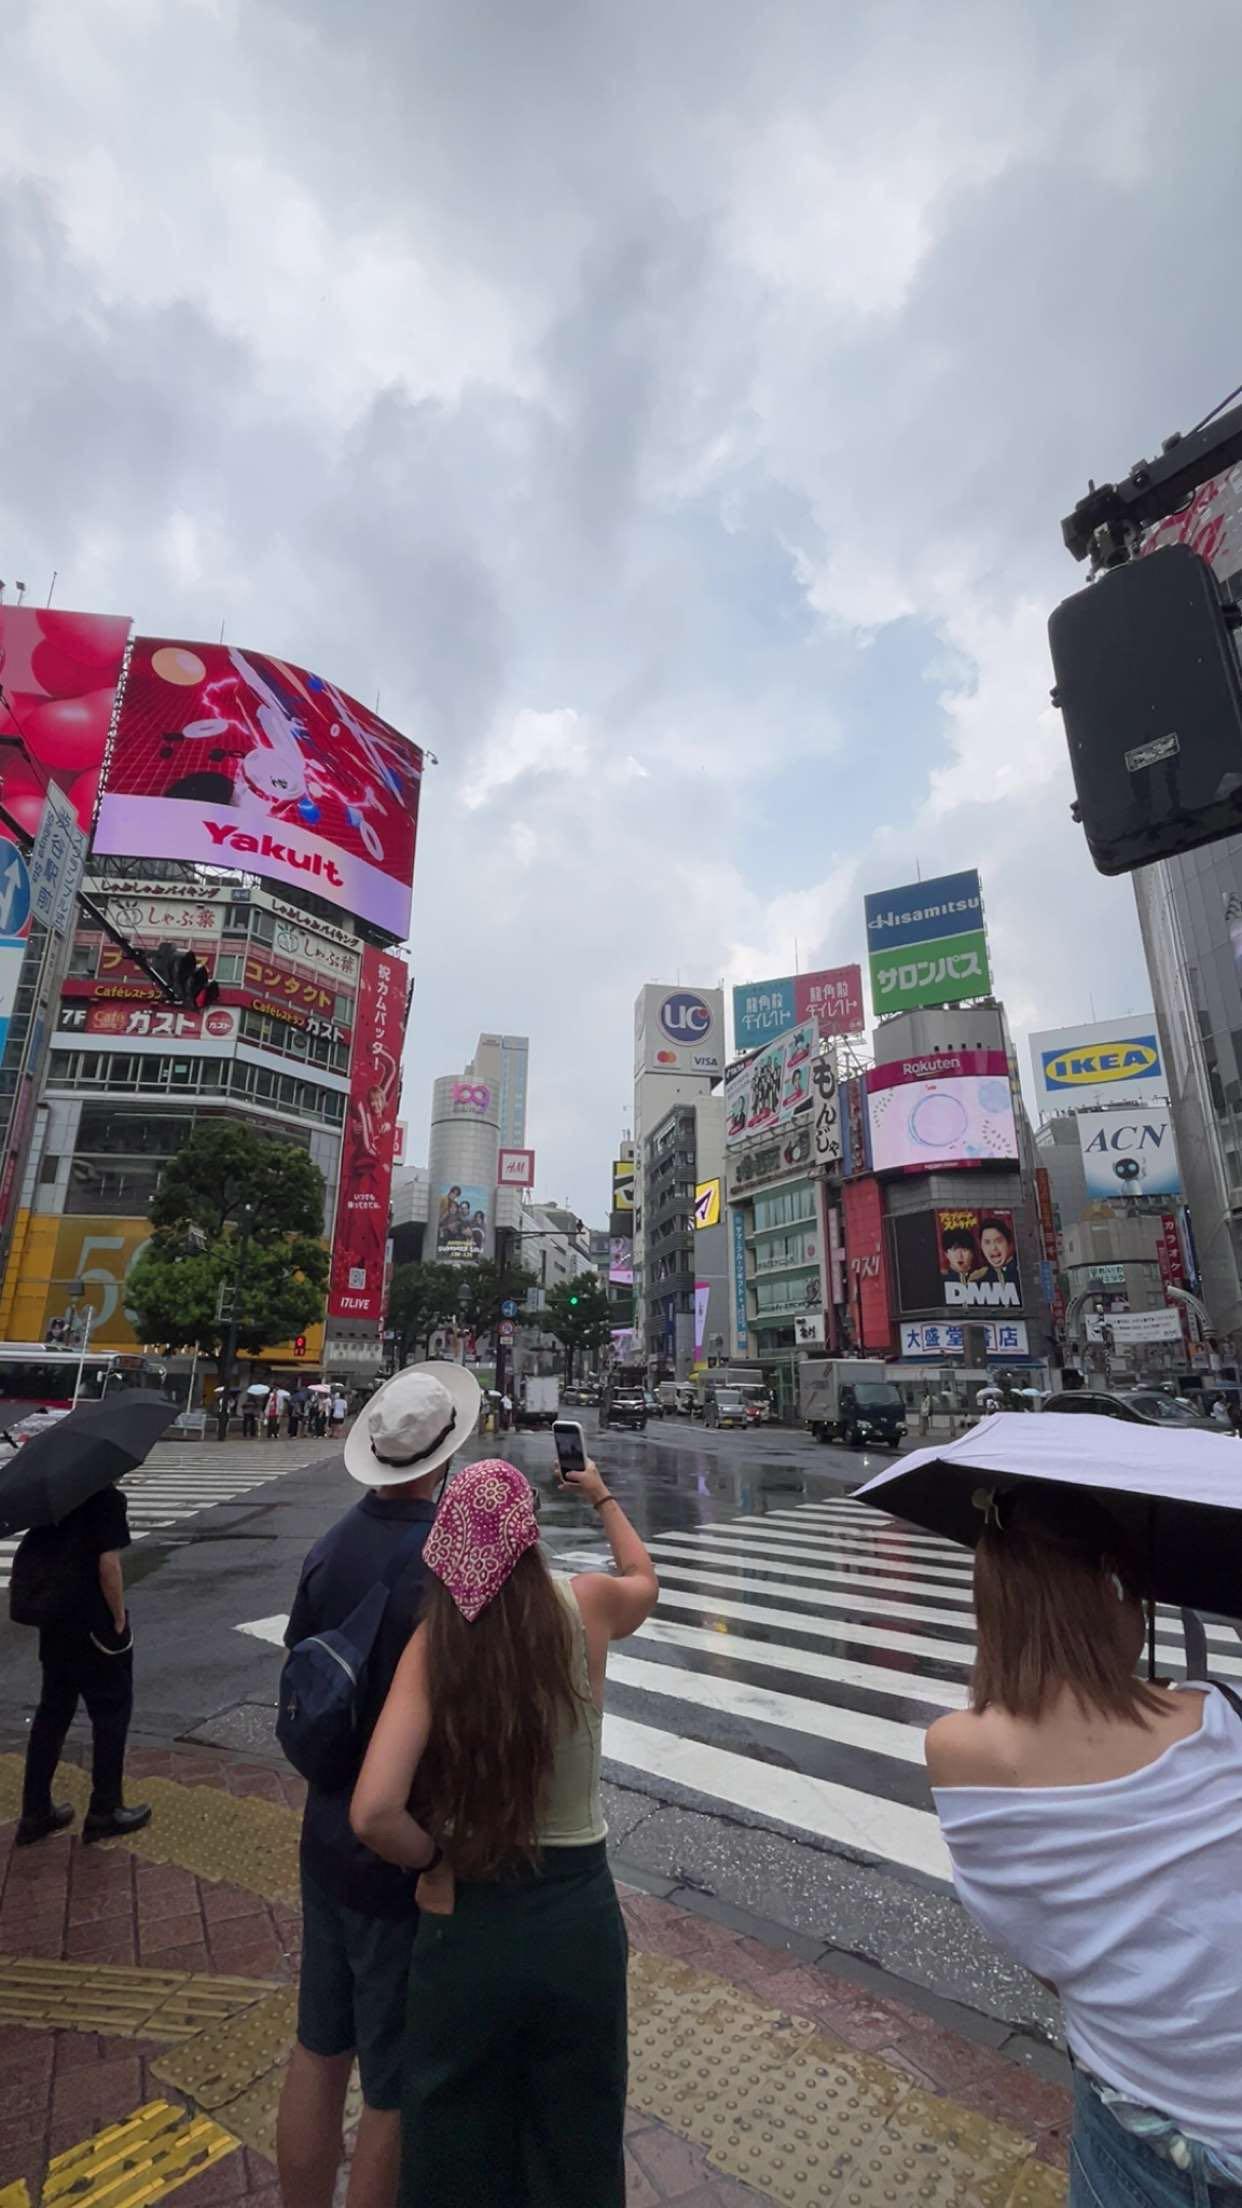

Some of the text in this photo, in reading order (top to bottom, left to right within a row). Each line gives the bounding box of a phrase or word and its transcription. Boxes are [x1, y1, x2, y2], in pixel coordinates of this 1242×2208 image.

[202, 820, 344, 887] Yakult
[867, 897, 980, 929] Hisamitsu
[245, 960, 332, 1008] コンタクト
[877, 951, 982, 994] サロンパス
[61, 1008, 87, 1026] 7F
[126, 1010, 195, 1036] ガスト
[306, 1016, 345, 1043] ガスト
[694, 1056, 718, 1066] VISA
[903, 1057, 961, 1076] Rakuten
[1055, 1050, 1149, 1077] IKEA
[813, 1057, 839, 1156] もんじゃ
[1084, 1123, 1168, 1152] ACN
[944, 1281, 1021, 1305] DMM
